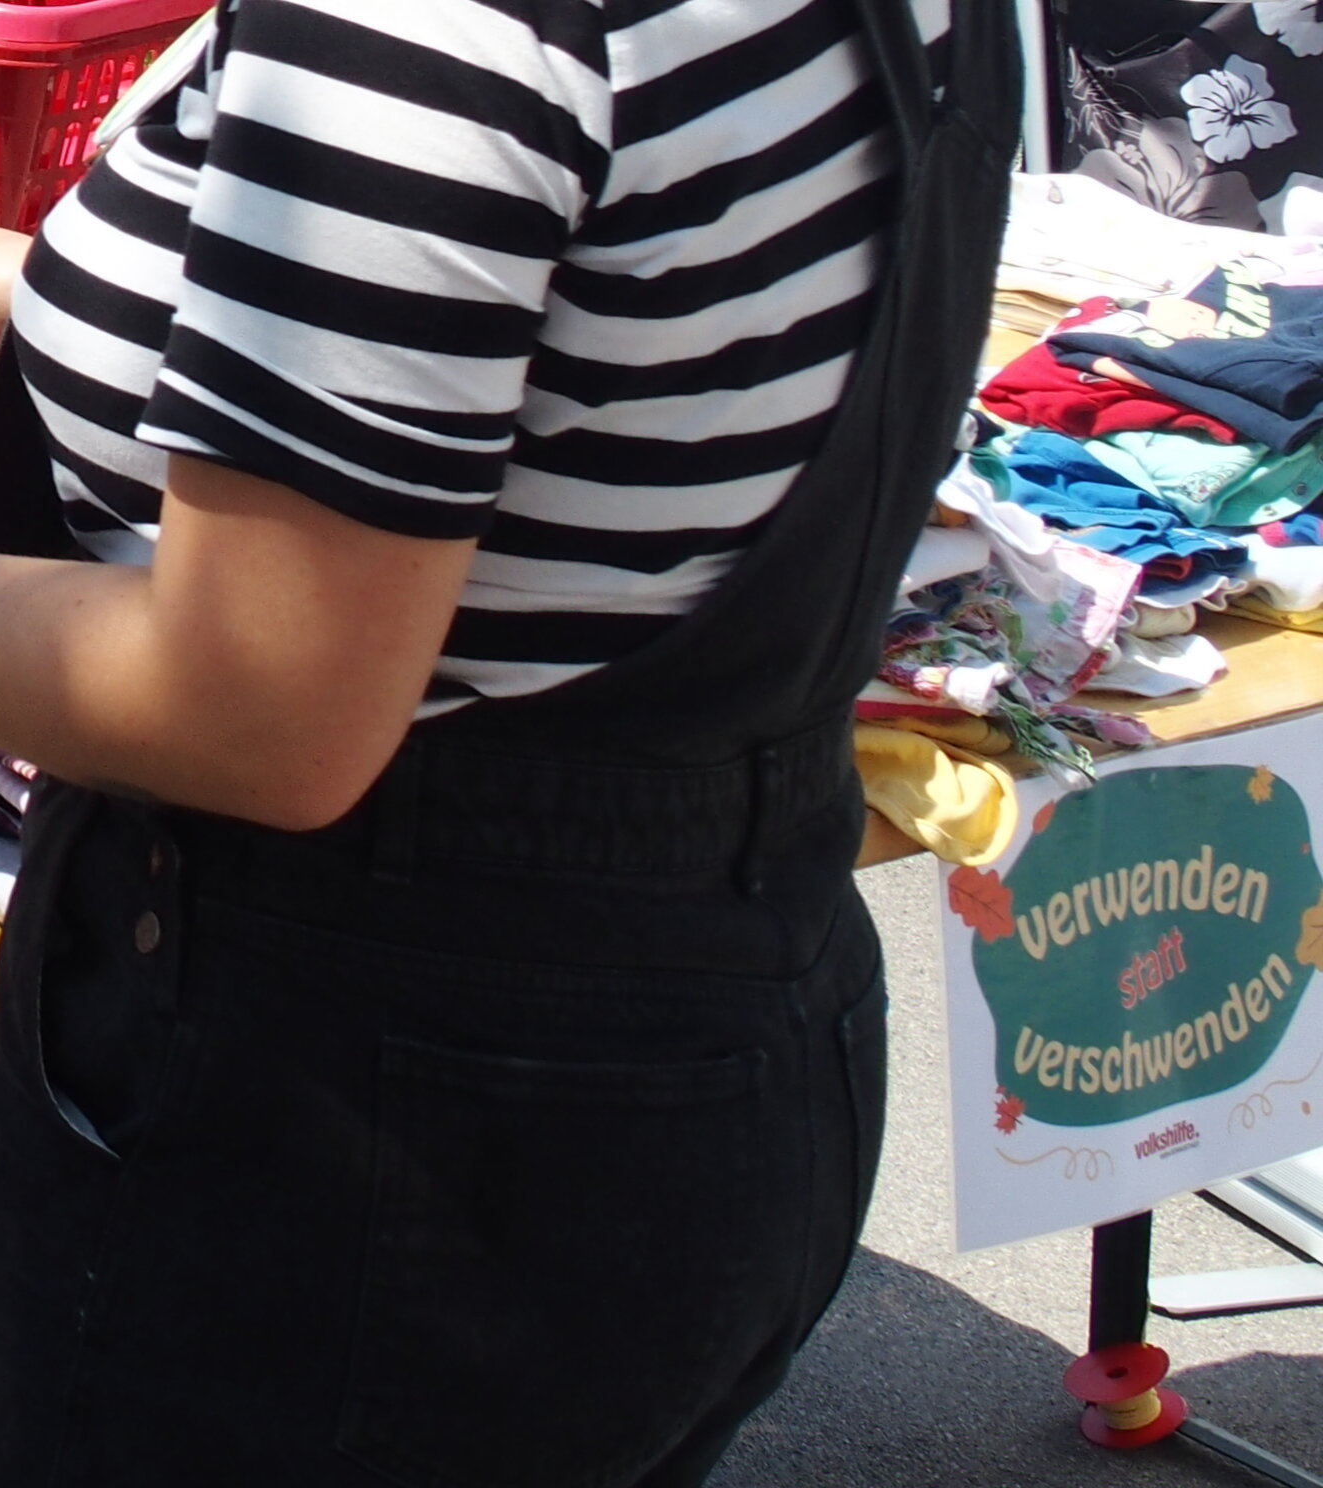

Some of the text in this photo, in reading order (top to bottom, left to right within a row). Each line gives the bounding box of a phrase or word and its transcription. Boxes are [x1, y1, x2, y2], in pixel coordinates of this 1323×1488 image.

[1016, 844, 1269, 961] verwenden
[1013, 953, 1293, 1094] verschwenden
[1118, 925, 1187, 1010] statt
